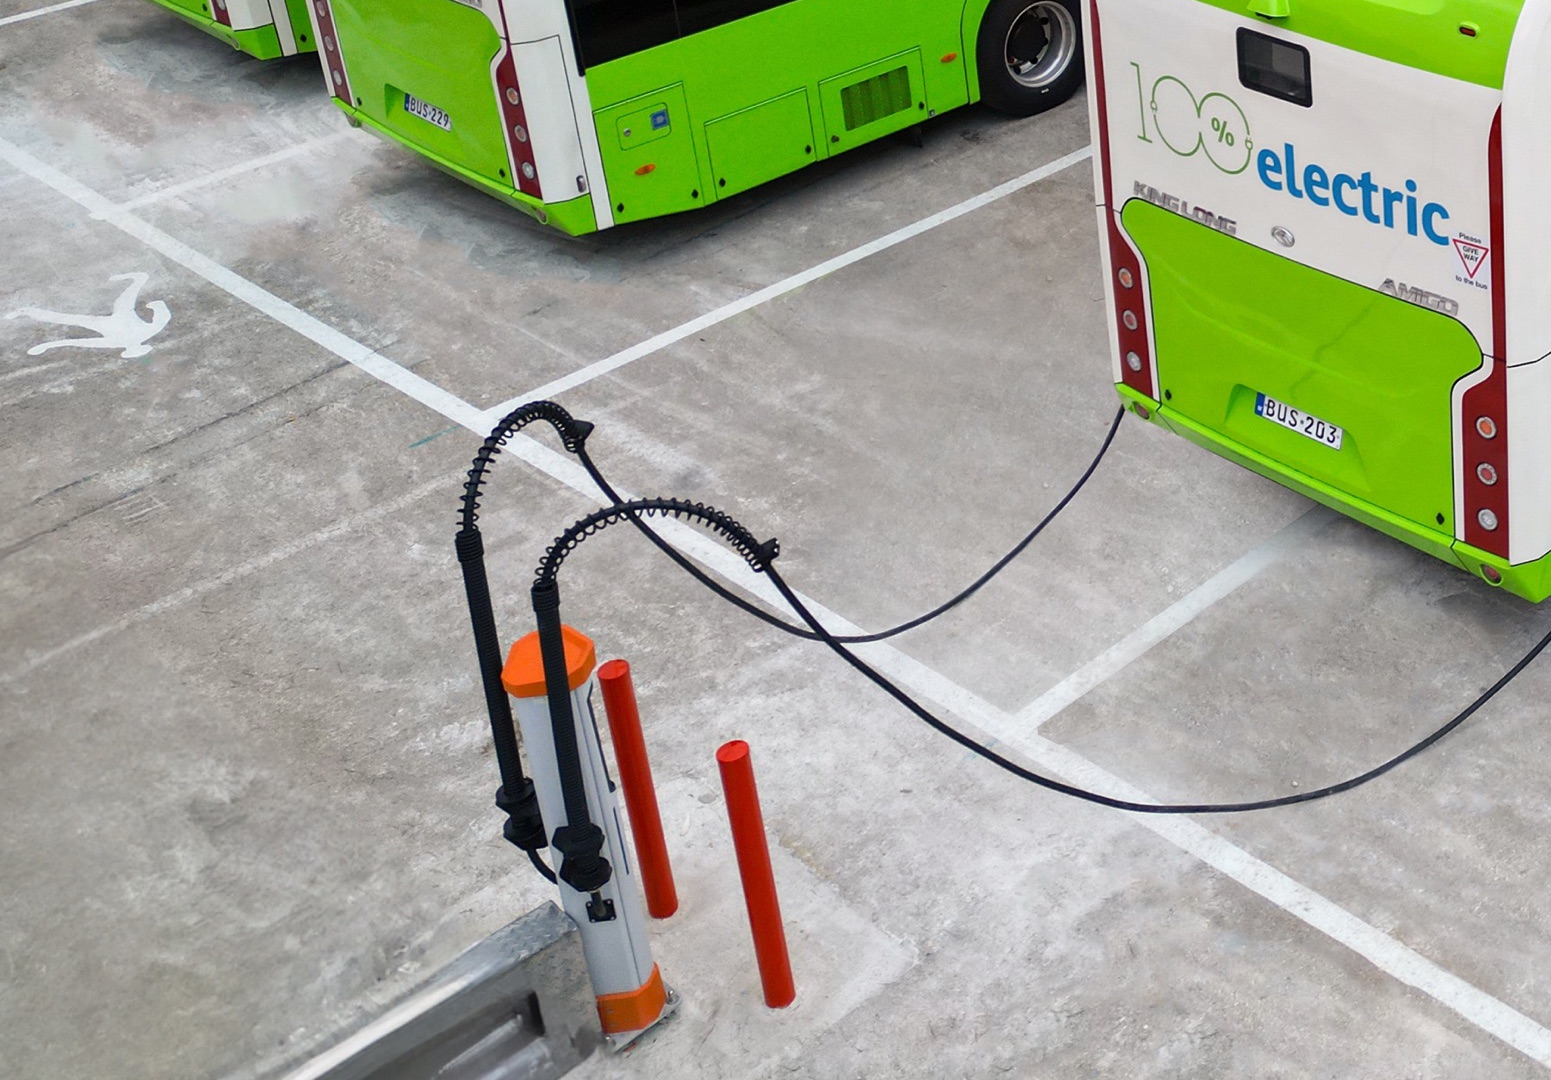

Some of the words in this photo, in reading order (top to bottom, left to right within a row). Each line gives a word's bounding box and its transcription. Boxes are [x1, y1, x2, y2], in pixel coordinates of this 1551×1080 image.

[1256, 142, 1451, 248] electric
[1458, 231, 1482, 244] Please
[1462, 245, 1479, 255] GIVE
[1462, 253, 1479, 262] WAY
[1463, 277, 1474, 285] the
[1475, 280, 1488, 290] bus
[1377, 278, 1459, 317] AMIGO
